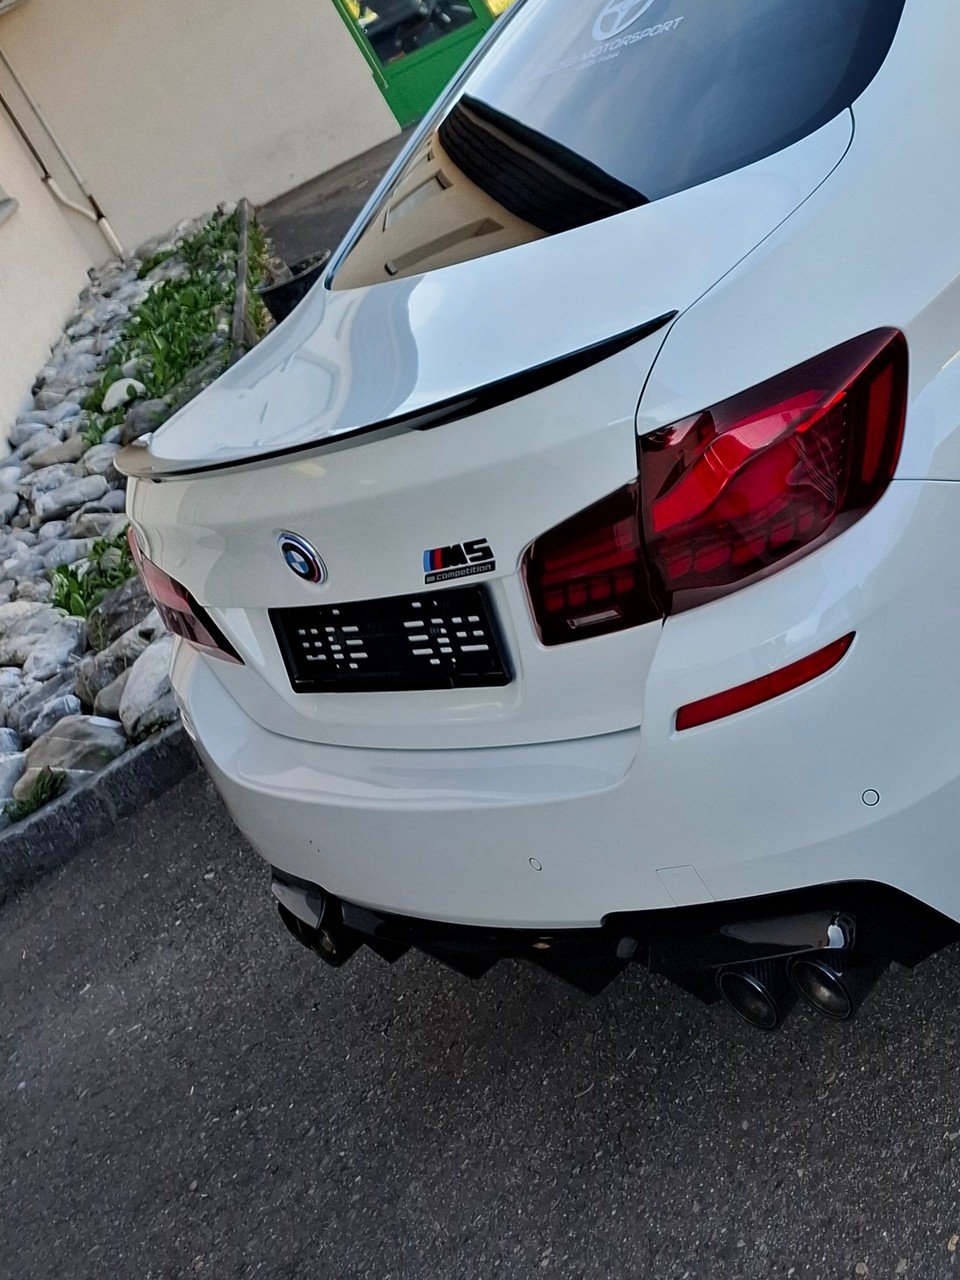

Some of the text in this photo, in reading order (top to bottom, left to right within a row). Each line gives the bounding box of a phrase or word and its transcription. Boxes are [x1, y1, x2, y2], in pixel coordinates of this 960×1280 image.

[580, 16, 685, 61] MOTORSPORT
[439, 536, 495, 570] M5
[436, 564, 493, 581] competition
